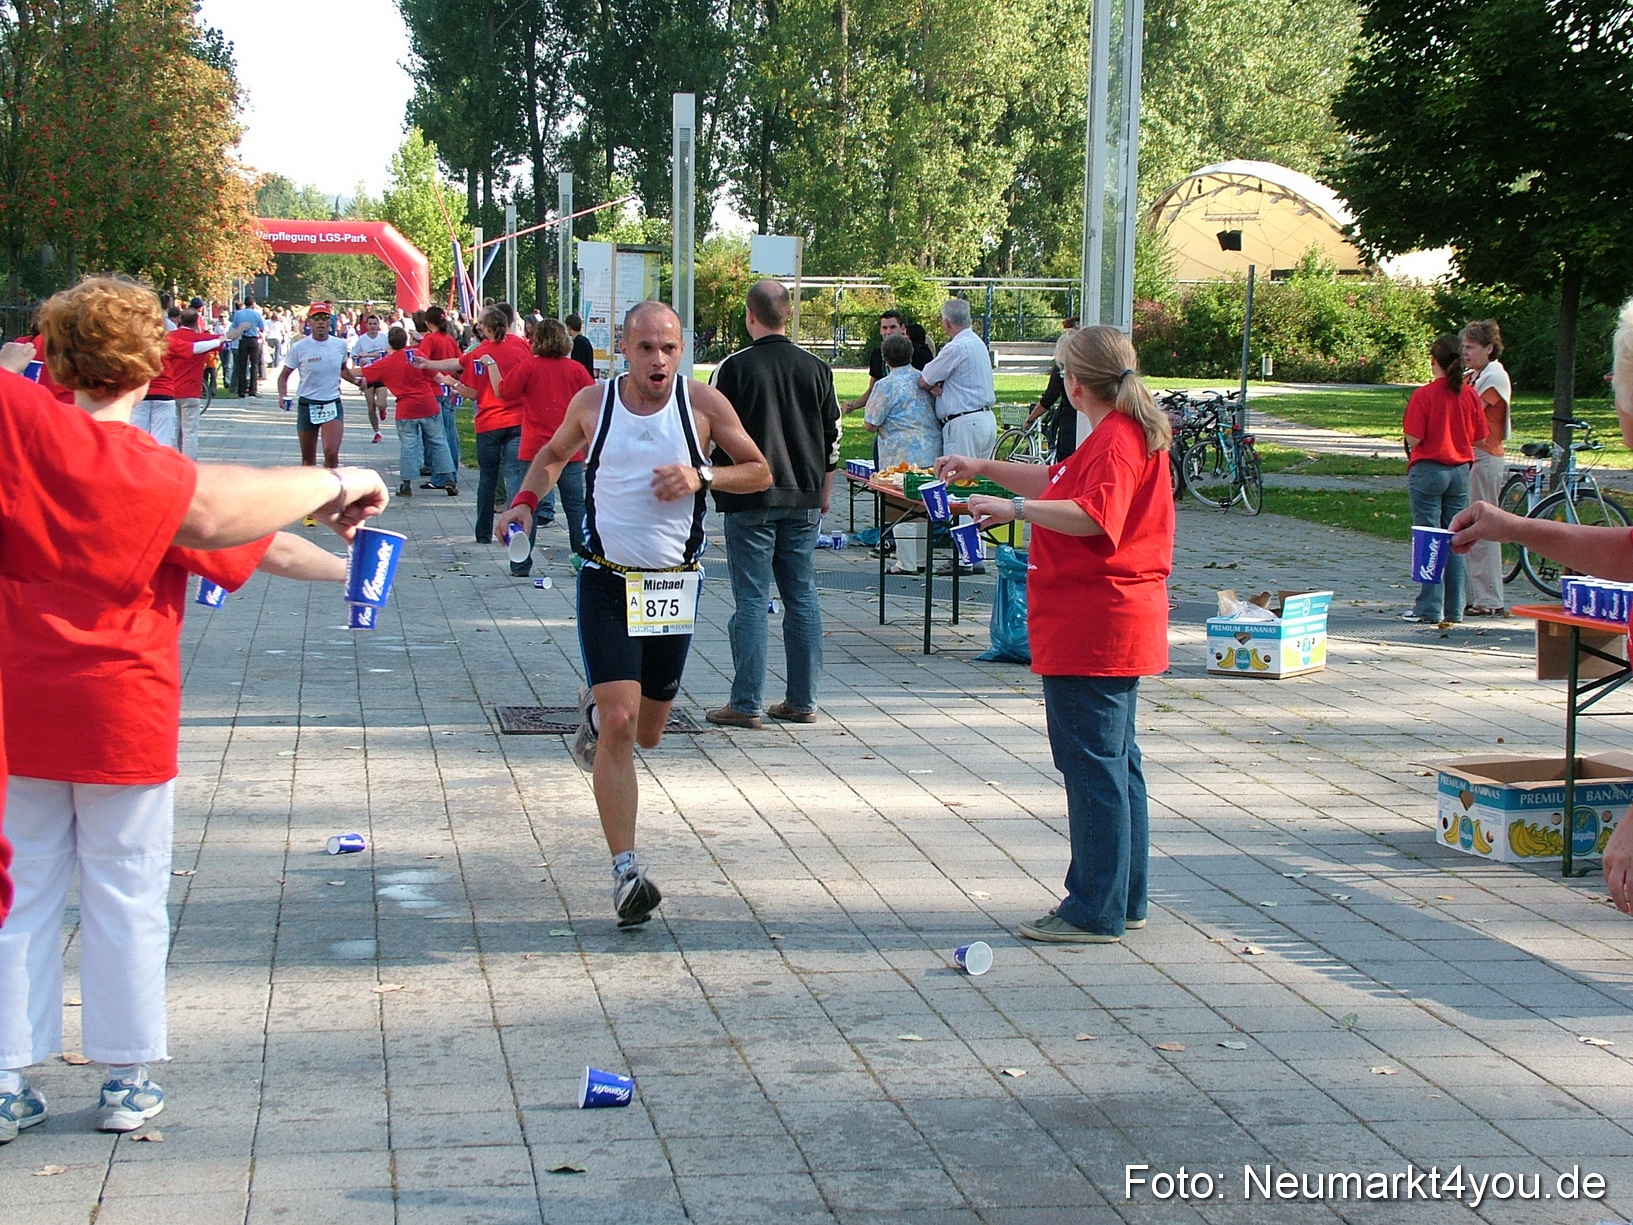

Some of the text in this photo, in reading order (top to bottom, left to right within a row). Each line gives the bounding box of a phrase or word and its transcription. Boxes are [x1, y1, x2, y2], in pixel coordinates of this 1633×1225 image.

[319, 233, 368, 243] LGS-Park
[1420, 536, 1441, 580] Xenofit
[643, 579, 685, 591] Michael
[630, 596, 638, 606] A
[645, 599, 680, 618] 875
[1244, 625, 1277, 634] BANANAS
